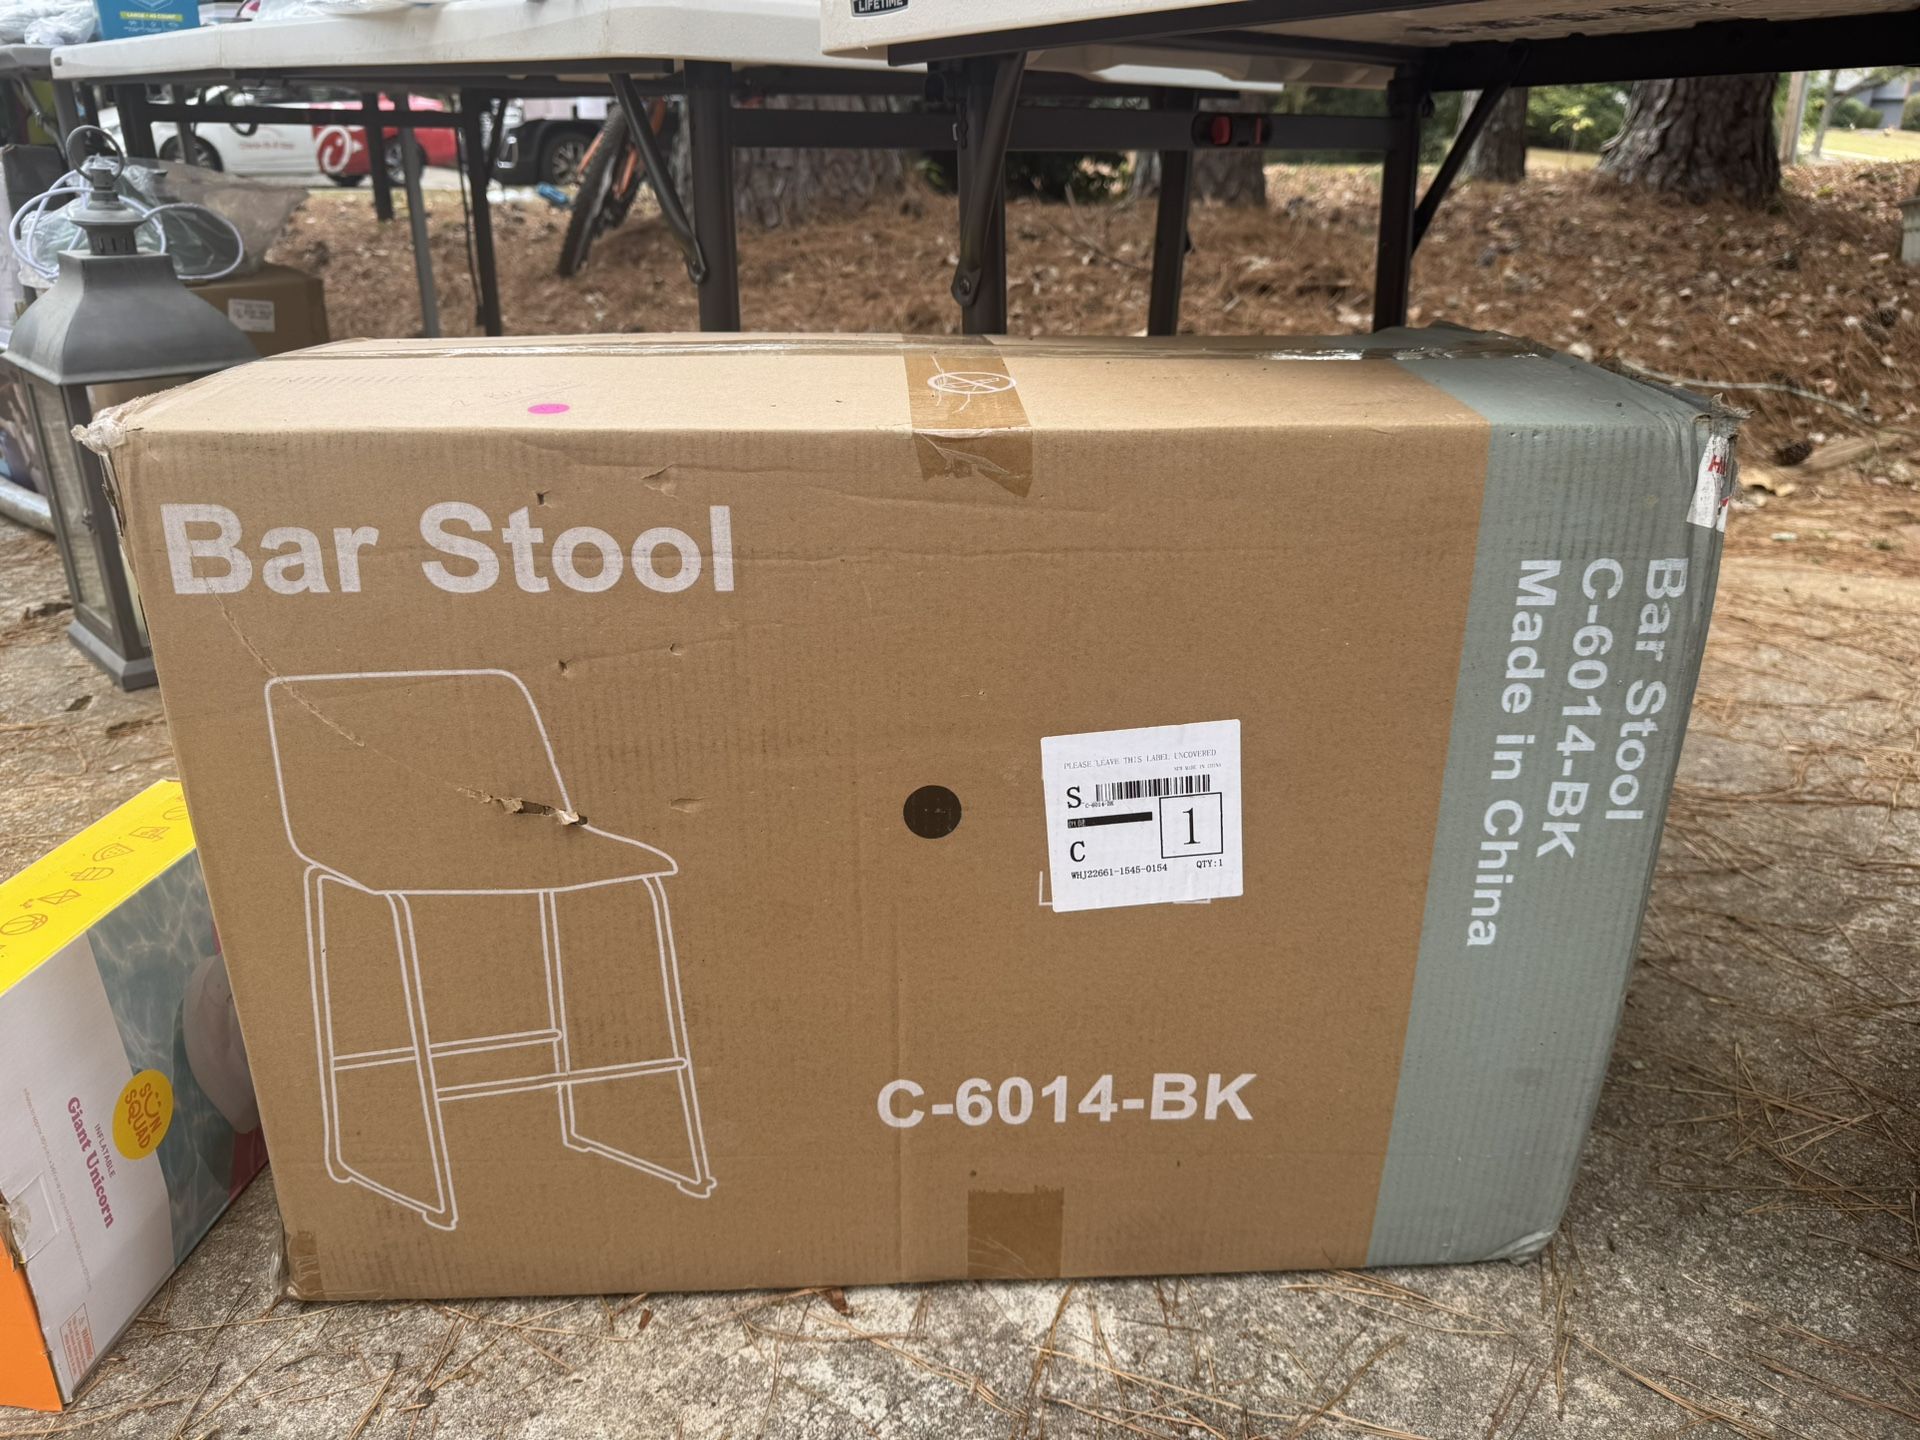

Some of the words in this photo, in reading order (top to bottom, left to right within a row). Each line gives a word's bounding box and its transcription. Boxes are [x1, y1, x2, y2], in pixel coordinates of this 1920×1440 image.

[859, 0, 903, 12] LIFETIME
[160, 503, 379, 594] Bar
[419, 501, 734, 593] Stool
[1501, 560, 1562, 713] Made
[1635, 558, 1688, 662] Bar
[1536, 558, 1623, 858] C-6014-BK
[1063, 760, 1092, 770] PLEASE
[1096, 757, 1120, 767] LEAVE
[1123, 755, 1143, 764] THIS
[1146, 753, 1170, 763] LABEL
[1174, 749, 1217, 760] UNCOVERED
[1491, 735, 1535, 780] in
[1605, 680, 1666, 820] Stool
[1066, 786, 1082, 809] S
[1070, 840, 1086, 863] C
[1182, 807, 1201, 846] 1
[1070, 863, 1168, 880] WHJ22661-1545-0154
[1196, 859, 1223, 869] QTY:1
[1467, 800, 1524, 946] China
[125, 1089, 151, 1149] SQUAD
[139, 1082, 162, 1133] SUN
[877, 1073, 1257, 1128] C-6014-BK
[68, 1097, 92, 1152] Giant
[86, 1150, 114, 1229] Unicorn
[94, 1123, 117, 1178] INFLATABLE
